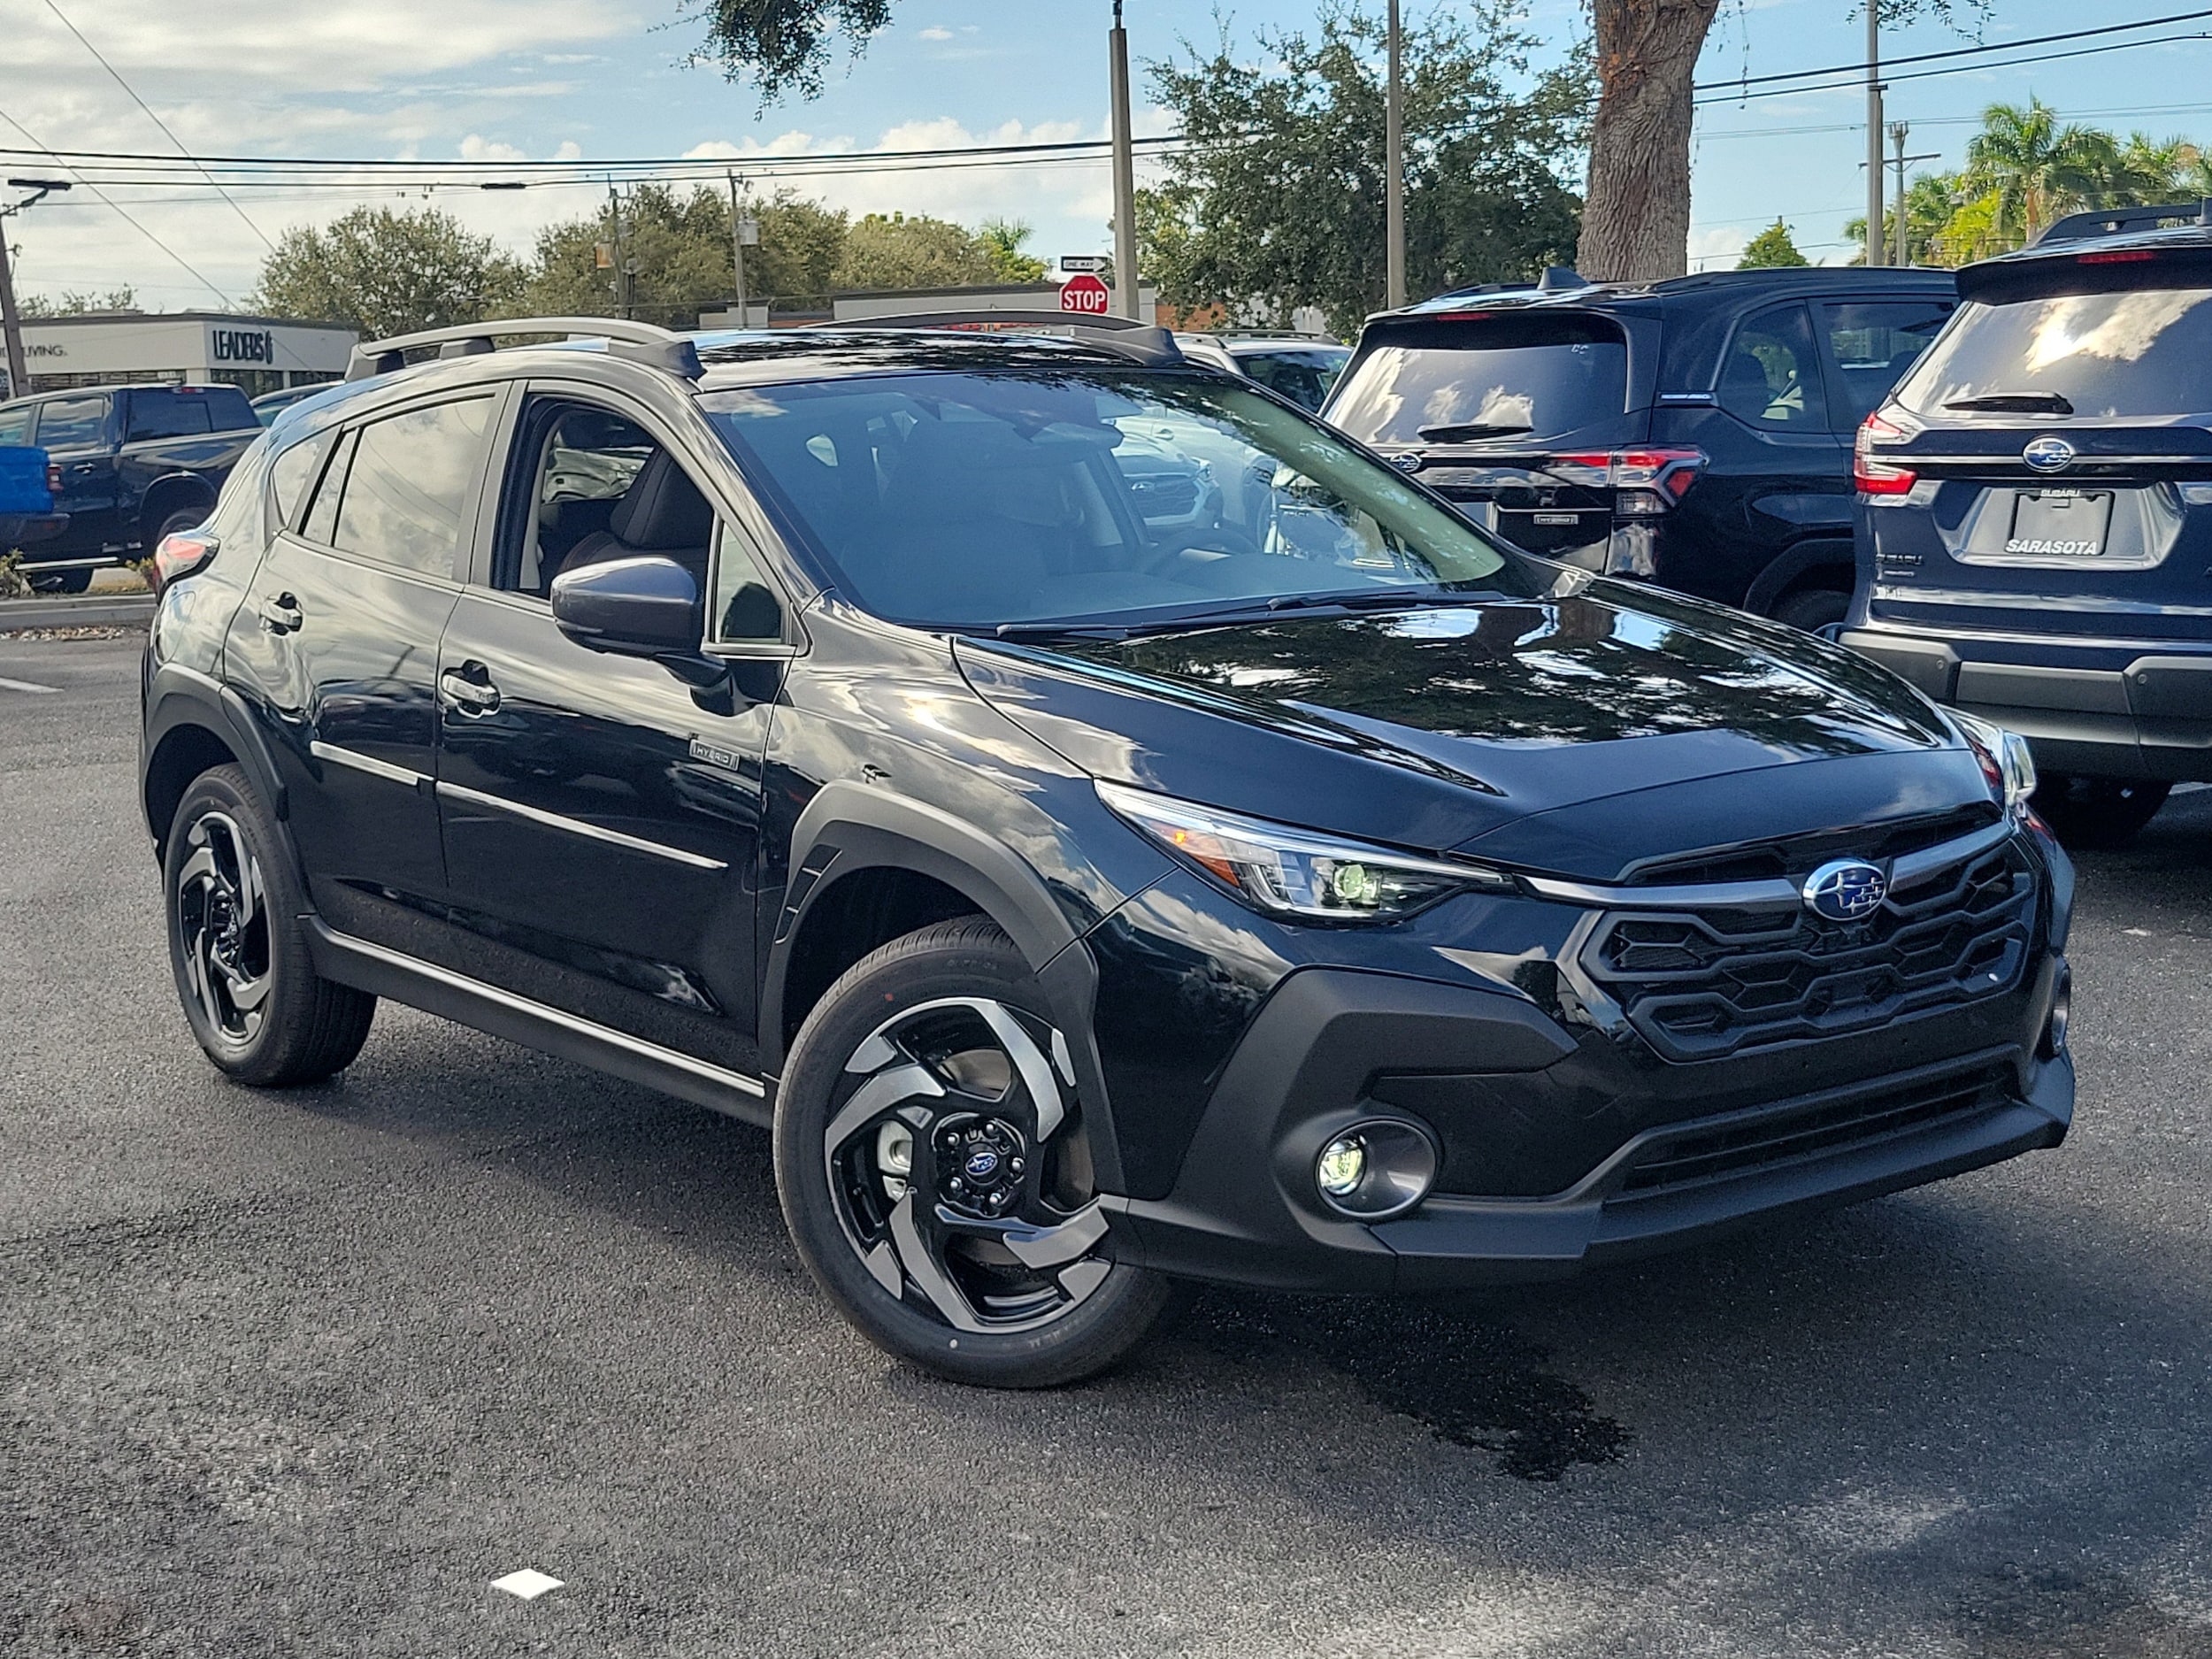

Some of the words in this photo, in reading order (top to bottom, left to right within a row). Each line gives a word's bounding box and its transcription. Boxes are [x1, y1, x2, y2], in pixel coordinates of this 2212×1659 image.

[1064, 290, 1106, 310] STOP
[212, 330, 265, 361] LEADERS
[2005, 538, 2098, 556] SARASOTA
[1876, 553, 1922, 565] SUBARU
[696, 743, 730, 764] HYBRID
